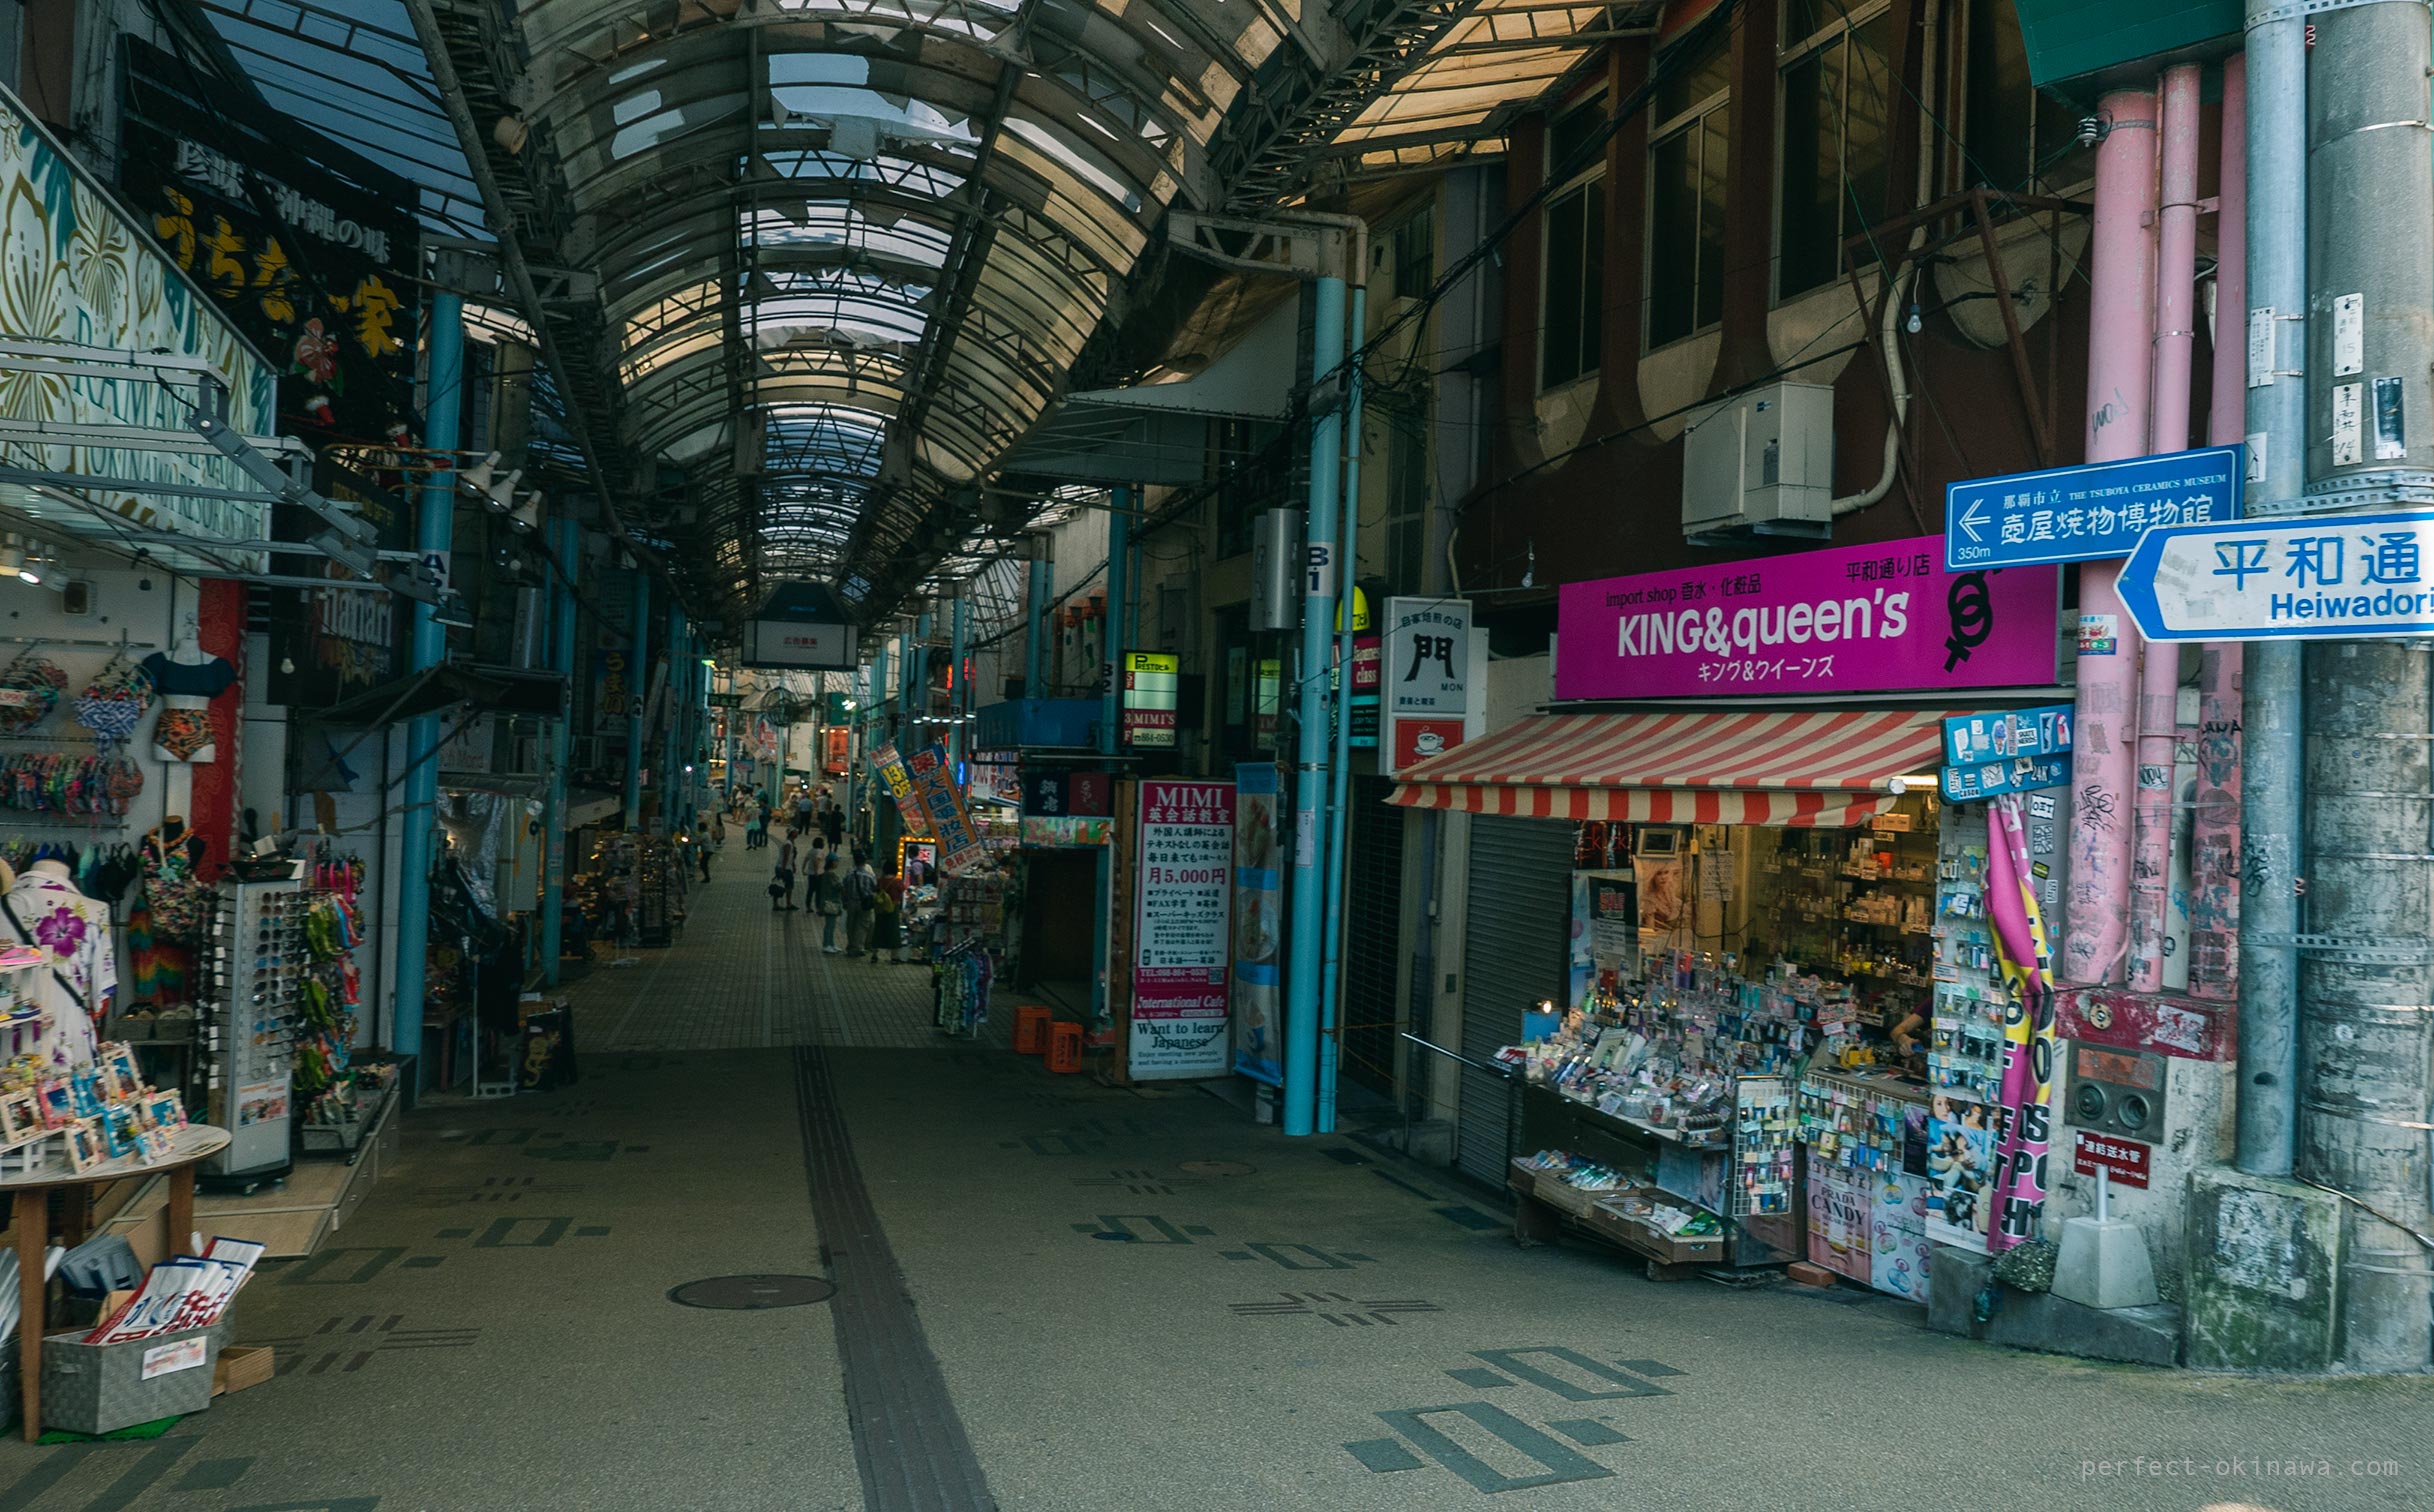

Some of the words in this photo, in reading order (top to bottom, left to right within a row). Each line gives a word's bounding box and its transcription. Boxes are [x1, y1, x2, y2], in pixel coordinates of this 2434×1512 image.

[2003, 490, 2061, 509] 那覇市立
[2069, 491, 2087, 501] THE
[2090, 486, 2129, 498] TSUBOYA
[2132, 479, 2181, 493] CERAMICS
[2184, 474, 2227, 487] MUSEUM
[1957, 546, 1991, 560] 350m
[2212, 531, 2421, 592] 平和通
[1845, 553, 1931, 583] 平和通り店
[1606, 590, 1643, 607] import
[1647, 585, 1677, 604] shop
[1617, 588, 1910, 658] KING&queen's
[1403, 633, 1456, 682] 門
[1355, 665, 1377, 684] class
[1698, 654, 1835, 682] キング&クイーンズ
[1441, 683, 1464, 692] MON
[1133, 713, 1176, 725] MIMI'S
[1156, 786, 1222, 808] MIMI
[1148, 806, 1230, 824] 英会話教室
[1153, 827, 1225, 838] 外国人講師による
[1146, 839, 1230, 850] テキストなしの英会話
[1148, 867, 1227, 886] 月5,000円
[1138, 995, 1201, 1009] International
[1137, 1022, 1171, 1035] Want
[1176, 1023, 1188, 1034] to
[1193, 1022, 1224, 1034] learn
[1152, 1036, 1208, 1050] Japanese
[1821, 1187, 1856, 1206] PRADA
[1811, 1194, 1867, 1226] CANDY
